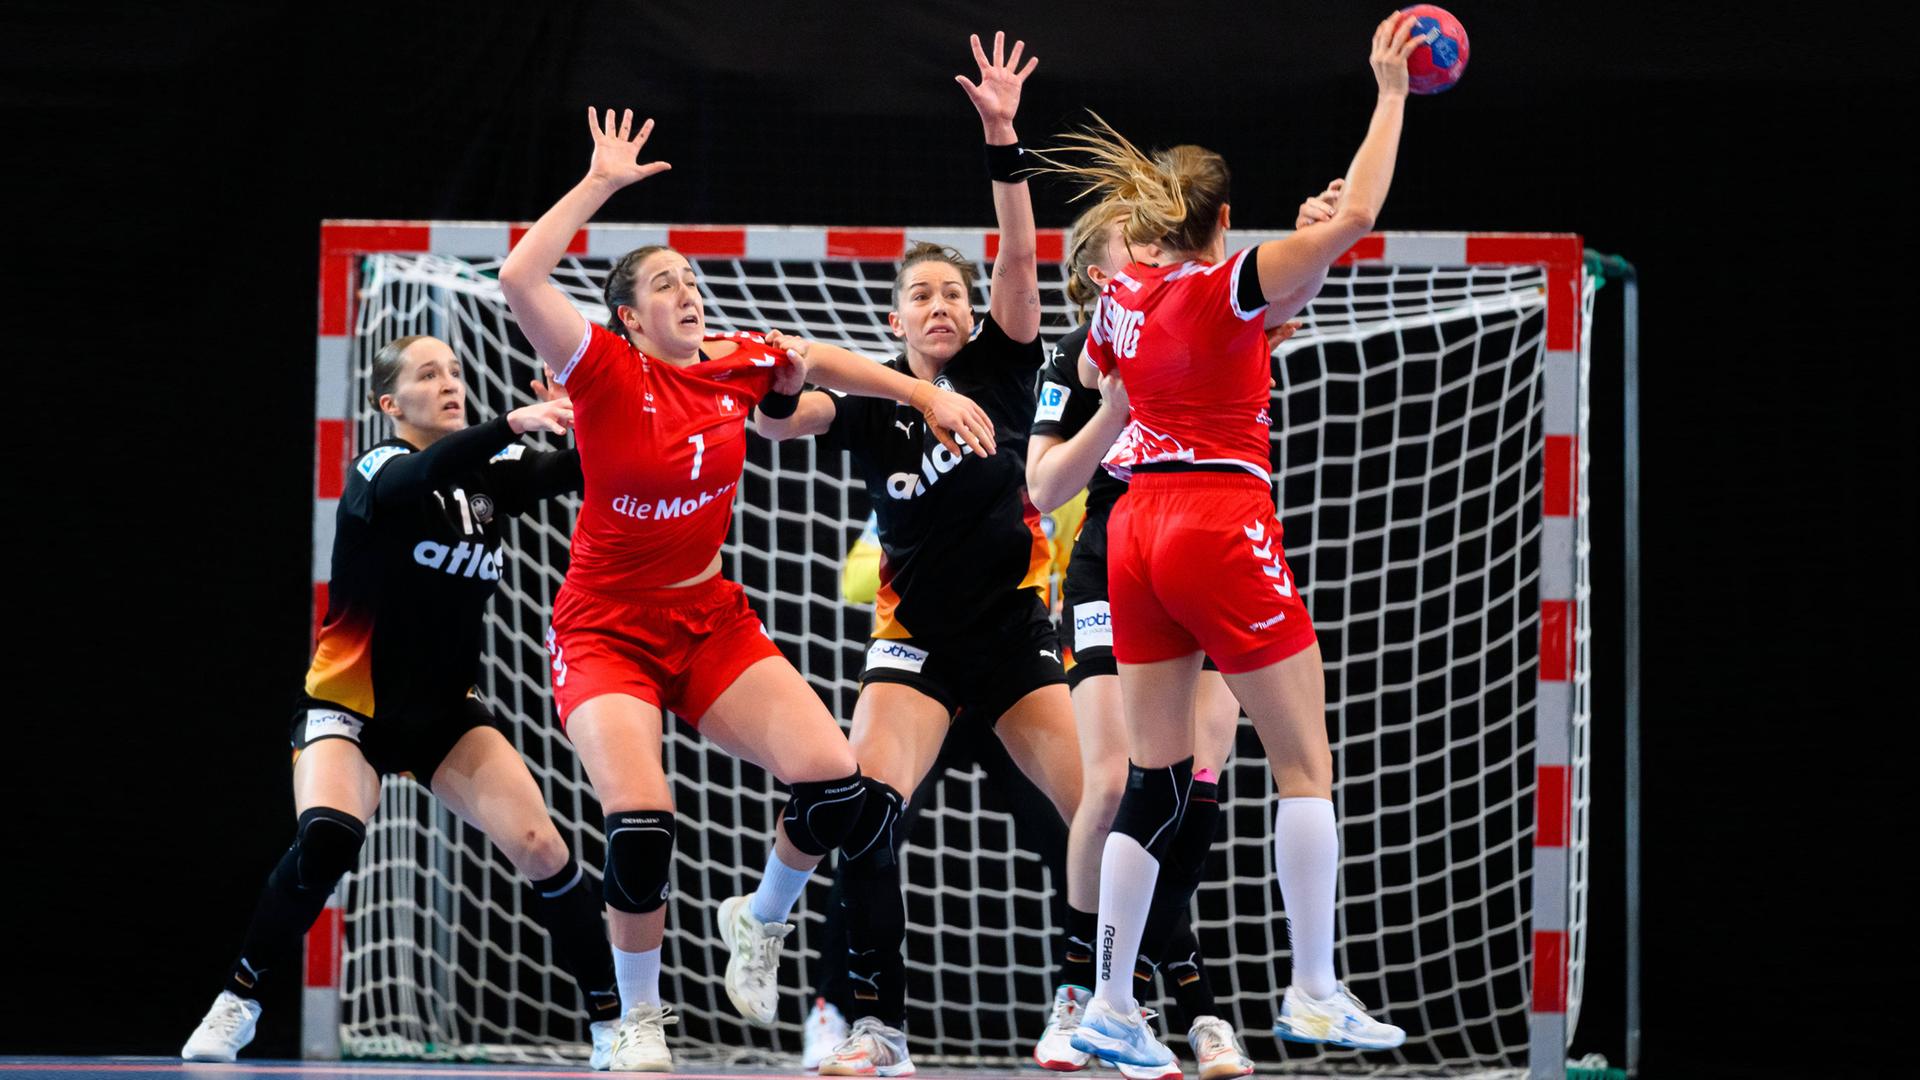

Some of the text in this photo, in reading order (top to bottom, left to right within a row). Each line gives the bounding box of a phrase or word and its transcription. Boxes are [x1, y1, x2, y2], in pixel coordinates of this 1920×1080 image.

[688, 434, 705, 480] 1
[612, 494, 651, 520] die
[1076, 612, 1112, 630] broth
